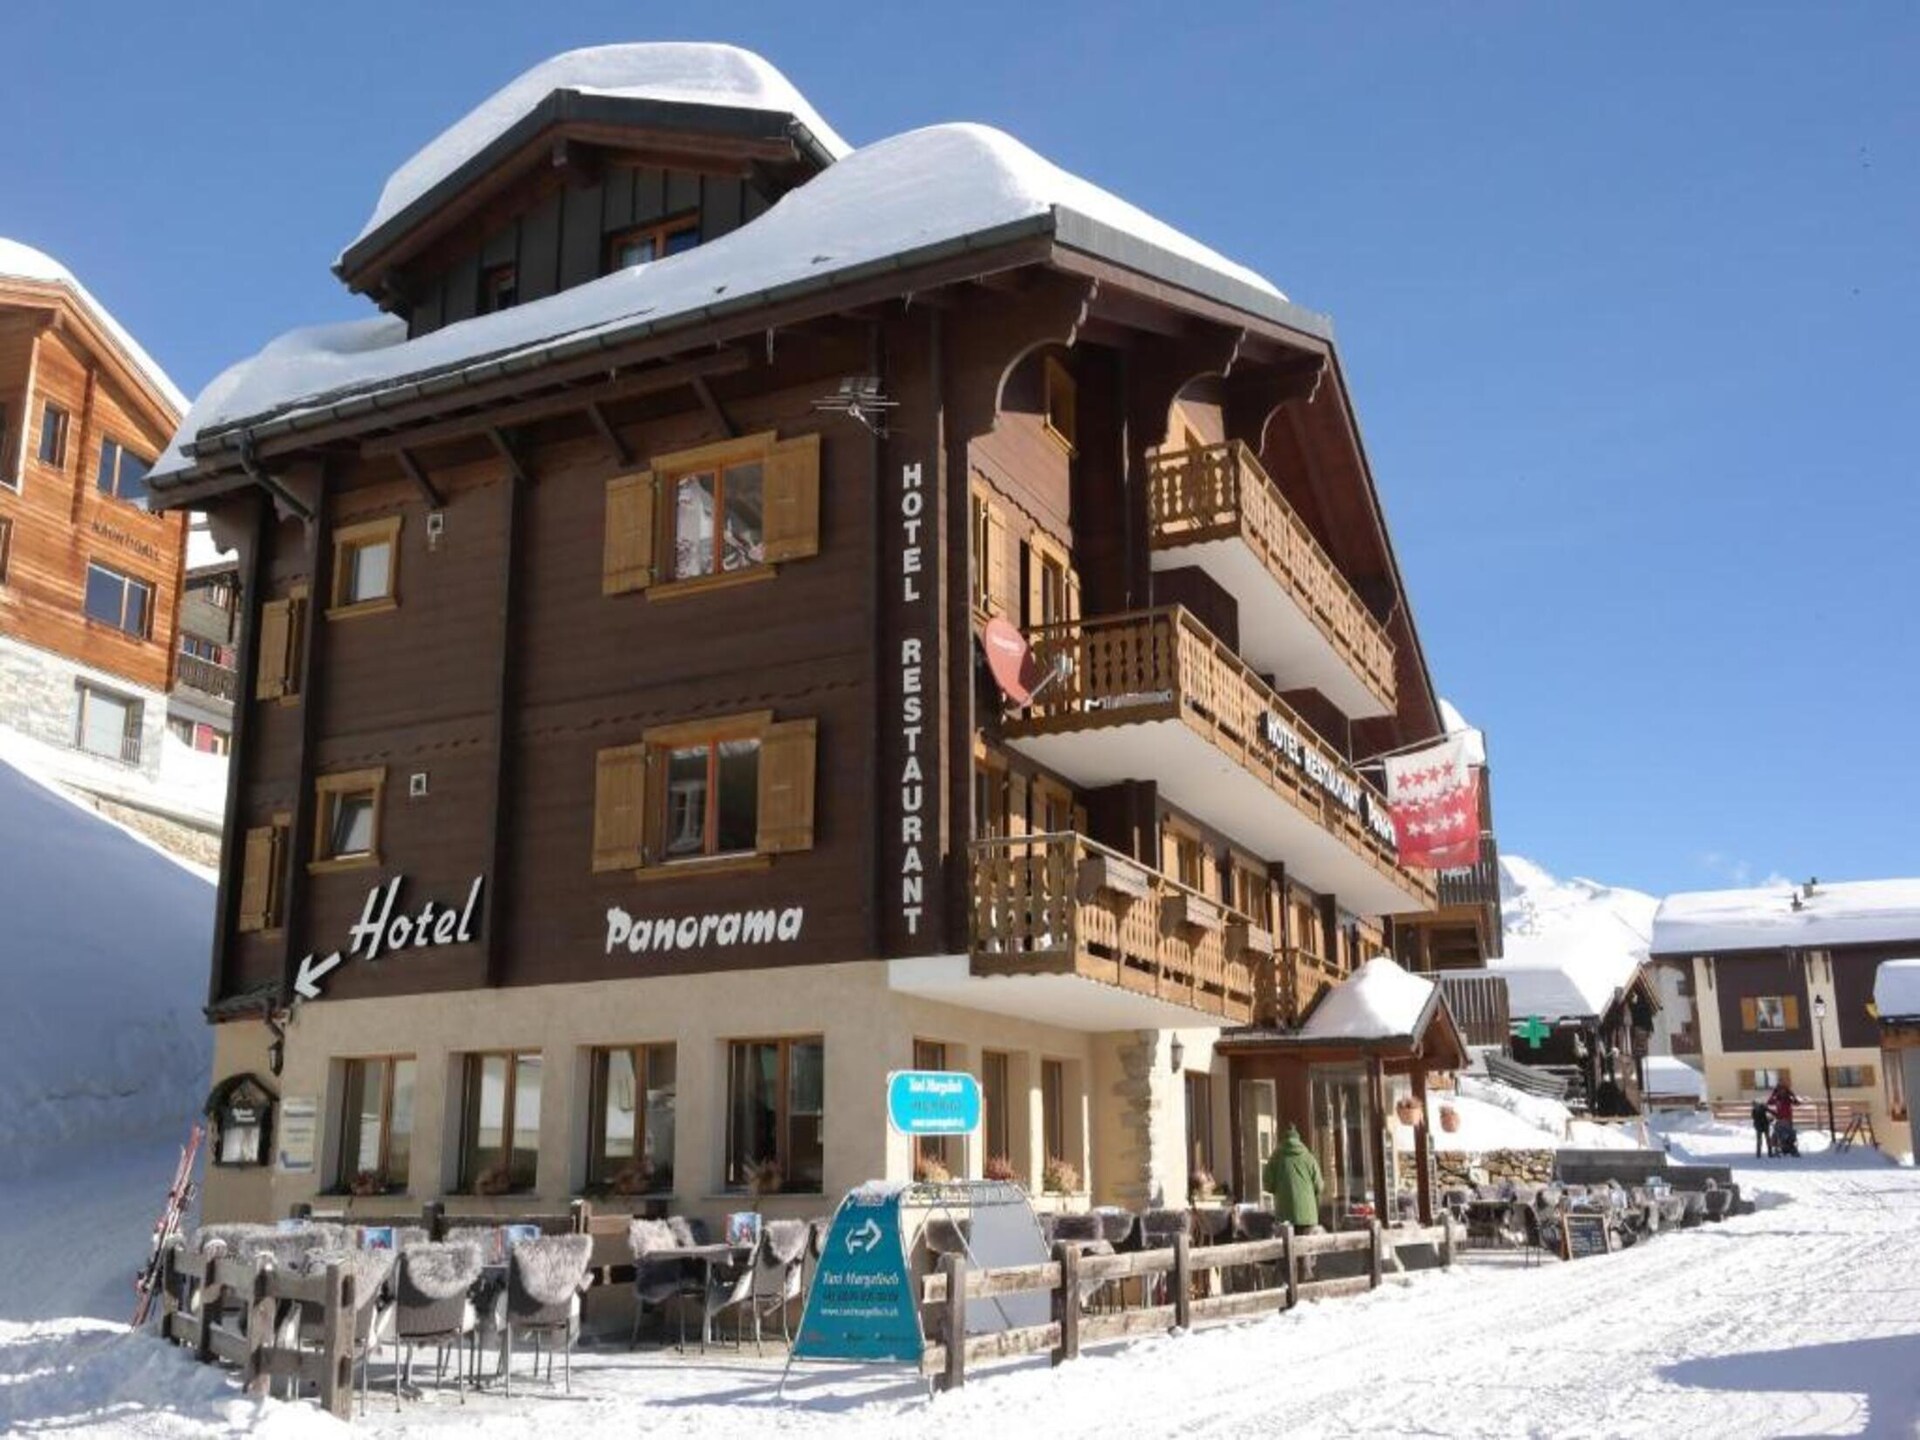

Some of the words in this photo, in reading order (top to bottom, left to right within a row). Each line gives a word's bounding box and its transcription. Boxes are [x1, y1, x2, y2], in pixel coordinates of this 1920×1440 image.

[901, 462, 923, 602] HOTEL
[1266, 710, 1302, 767] HOTEL
[901, 637, 924, 935] RESTAURANT
[349, 874, 483, 961] Hotel
[606, 905, 804, 955] Panorama
